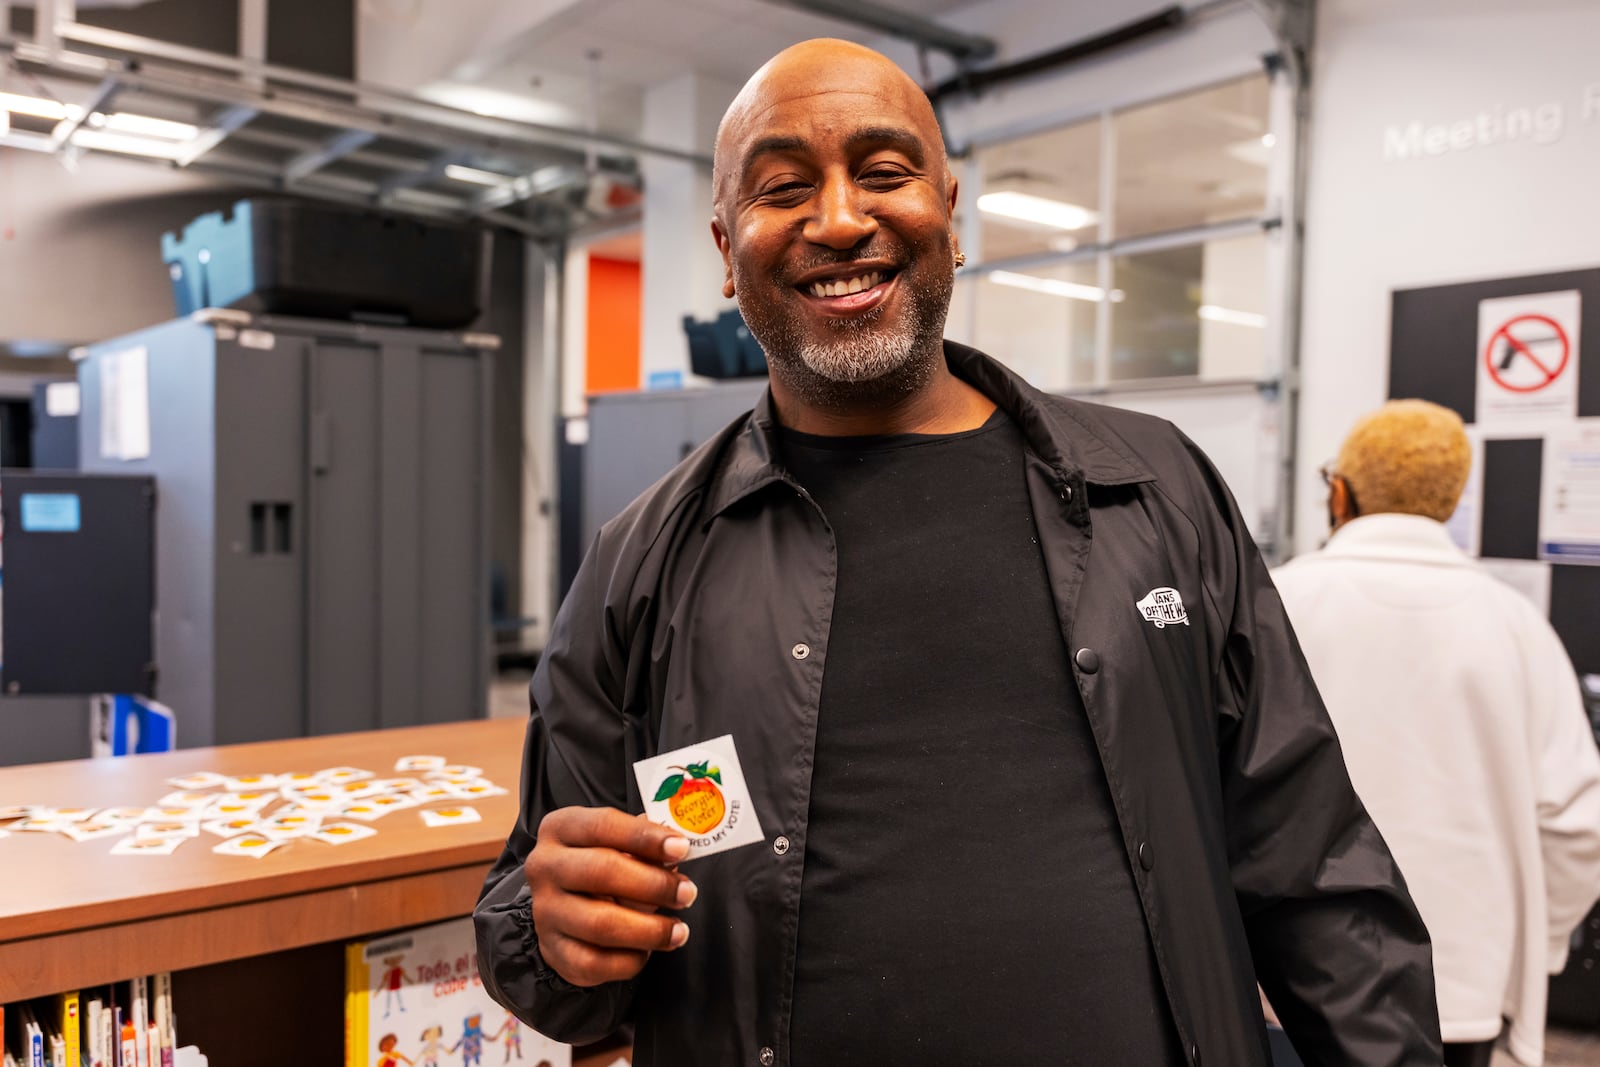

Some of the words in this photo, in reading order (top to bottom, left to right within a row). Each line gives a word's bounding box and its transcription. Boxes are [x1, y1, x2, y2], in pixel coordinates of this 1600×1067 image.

[1383, 103, 1565, 163] Meeting
[1152, 590, 1175, 603] VANS
[1159, 603, 1176, 619] THE
[674, 789, 716, 820] Georgia
[687, 806, 716, 826] Voter
[712, 830, 727, 842] MY
[416, 959, 451, 983] Todo
[455, 952, 469, 973] el
